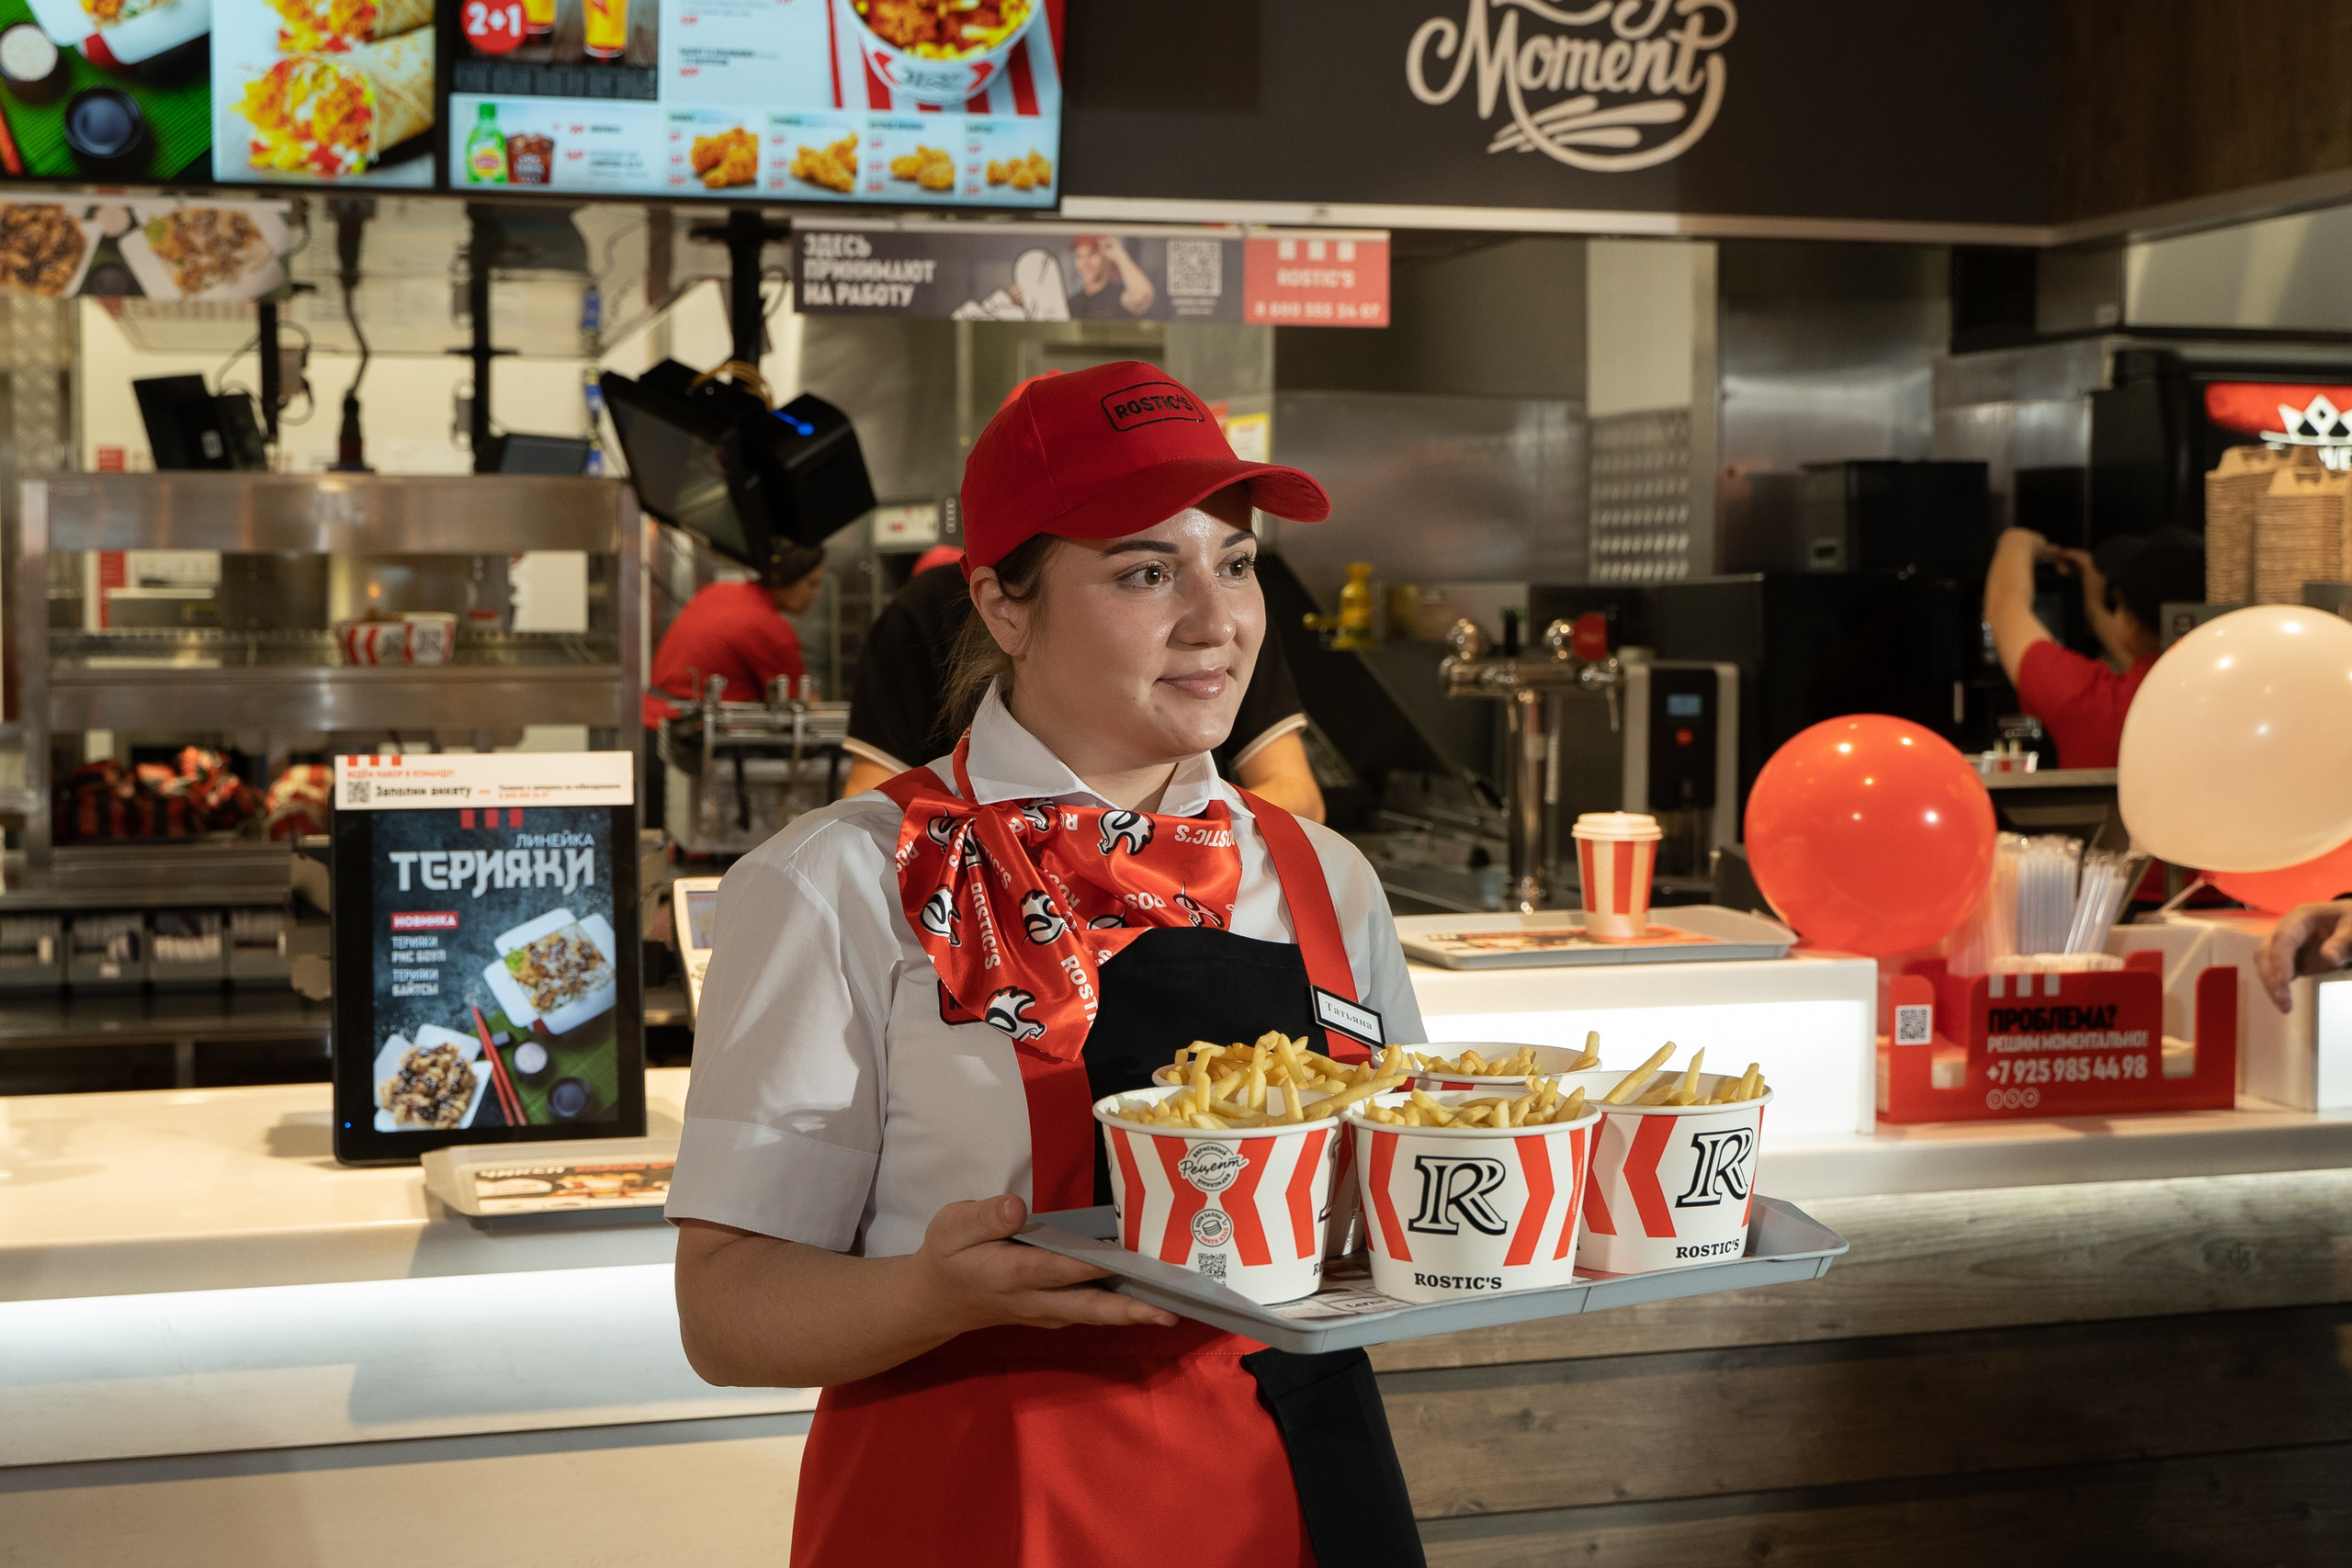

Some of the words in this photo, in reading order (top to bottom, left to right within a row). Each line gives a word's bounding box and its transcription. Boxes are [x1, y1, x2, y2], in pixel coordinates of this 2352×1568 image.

[467, 2, 522, 38] 2+1
[1406, 2, 1736, 138] Moment
[803, 232, 873, 258] ЗДЕСЬ
[803, 258, 937, 284] ПРИНИМАЮТ
[803, 281, 834, 306] НА
[835, 282, 916, 307] РАБОТУ
[1114, 394, 1193, 420] ROSTIC'S
[514, 829, 595, 849] ЛИНЕЙКА
[389, 848, 595, 899] ТЕРИЯКИ
[393, 915, 457, 928] НОВИНКА
[391, 936, 438, 949] ТЕРИЯКИ
[391, 968, 439, 982] ТЕРИЯКИ
[1324, 1000, 1373, 1031] Татьяна
[1988, 1003, 2118, 1032] ПРОБЛЕМА?
[1986, 1034, 2041, 1054] РЕШИМ
[2041, 1030, 2149, 1052] МОМЕНТАЛЬНО!
[1986, 1059, 2012, 1085] +7
[2012, 1058, 2052, 1084] 925
[2052, 1056, 2091, 1082] 985
[2092, 1055, 2120, 1080] 44
[2121, 1054, 2149, 1079] 98
[1180, 1156, 1248, 1177] Рецепт
[1675, 1127, 1754, 1210] R
[1408, 1155, 1508, 1236] R
[1675, 1237, 1740, 1258] ROSTIC'S
[1413, 1271, 1503, 1290] ROSTIC'S
